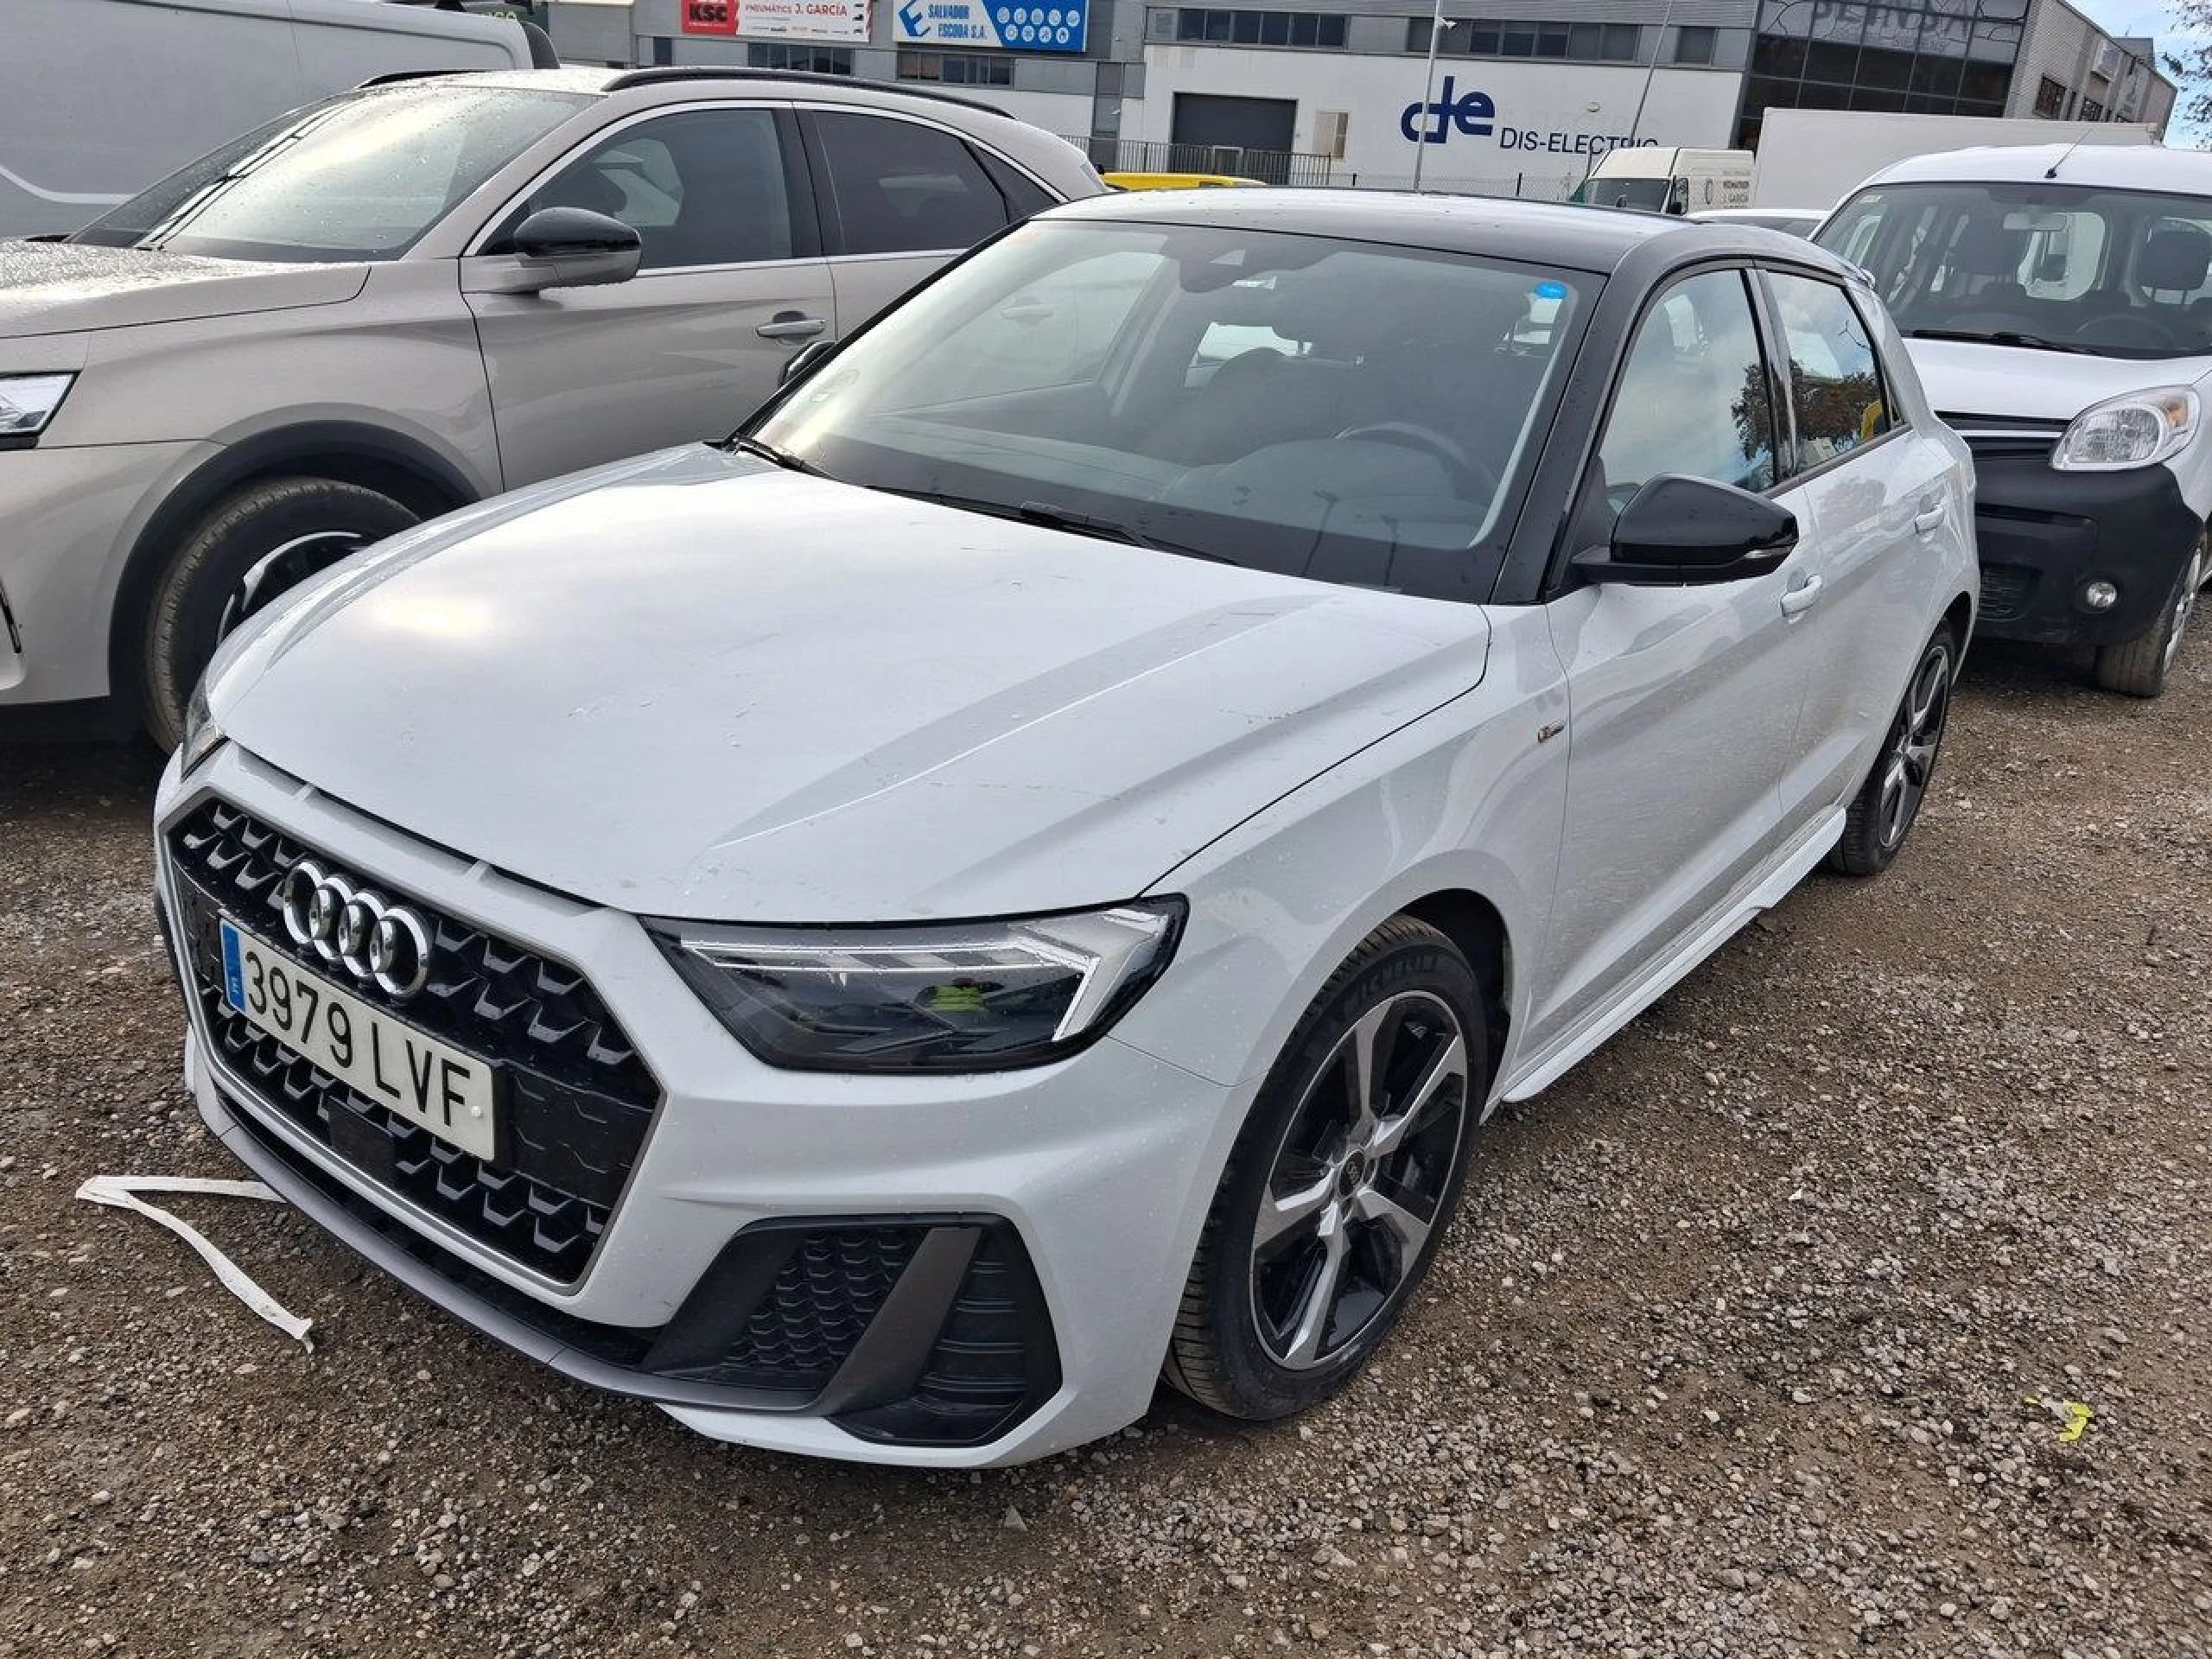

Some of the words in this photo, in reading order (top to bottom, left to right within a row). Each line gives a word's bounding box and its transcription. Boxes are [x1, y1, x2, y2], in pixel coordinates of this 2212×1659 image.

[690, 3, 728, 22] KSC
[929, 4, 970, 20] SALVADOR
[1401, 75, 1496, 143] de
[245, 951, 353, 1068] 3979
[372, 1021, 470, 1126] LVF
